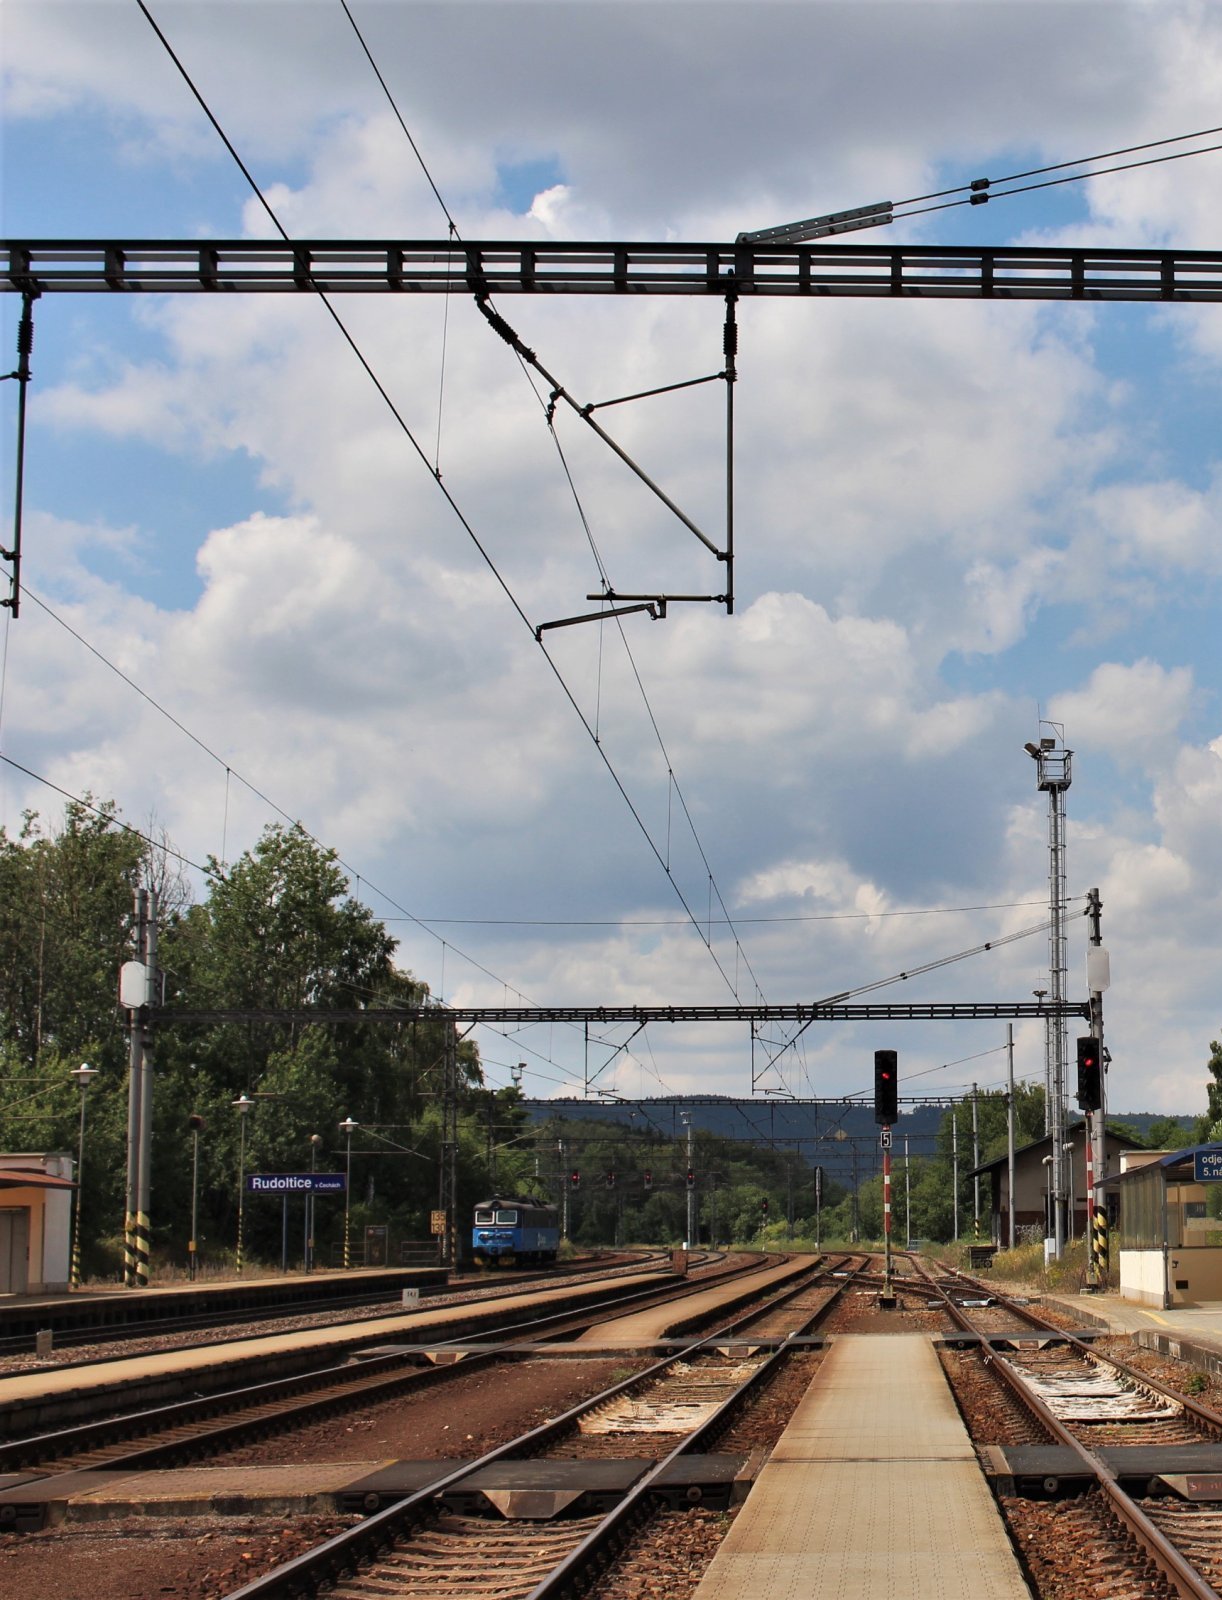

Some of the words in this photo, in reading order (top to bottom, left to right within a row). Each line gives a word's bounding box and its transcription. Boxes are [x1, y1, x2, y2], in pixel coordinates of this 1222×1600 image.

[883, 1133, 890, 1146] 5
[1203, 1168, 1211, 1176] 5.
[252, 1177, 312, 1189] Rudoltice
